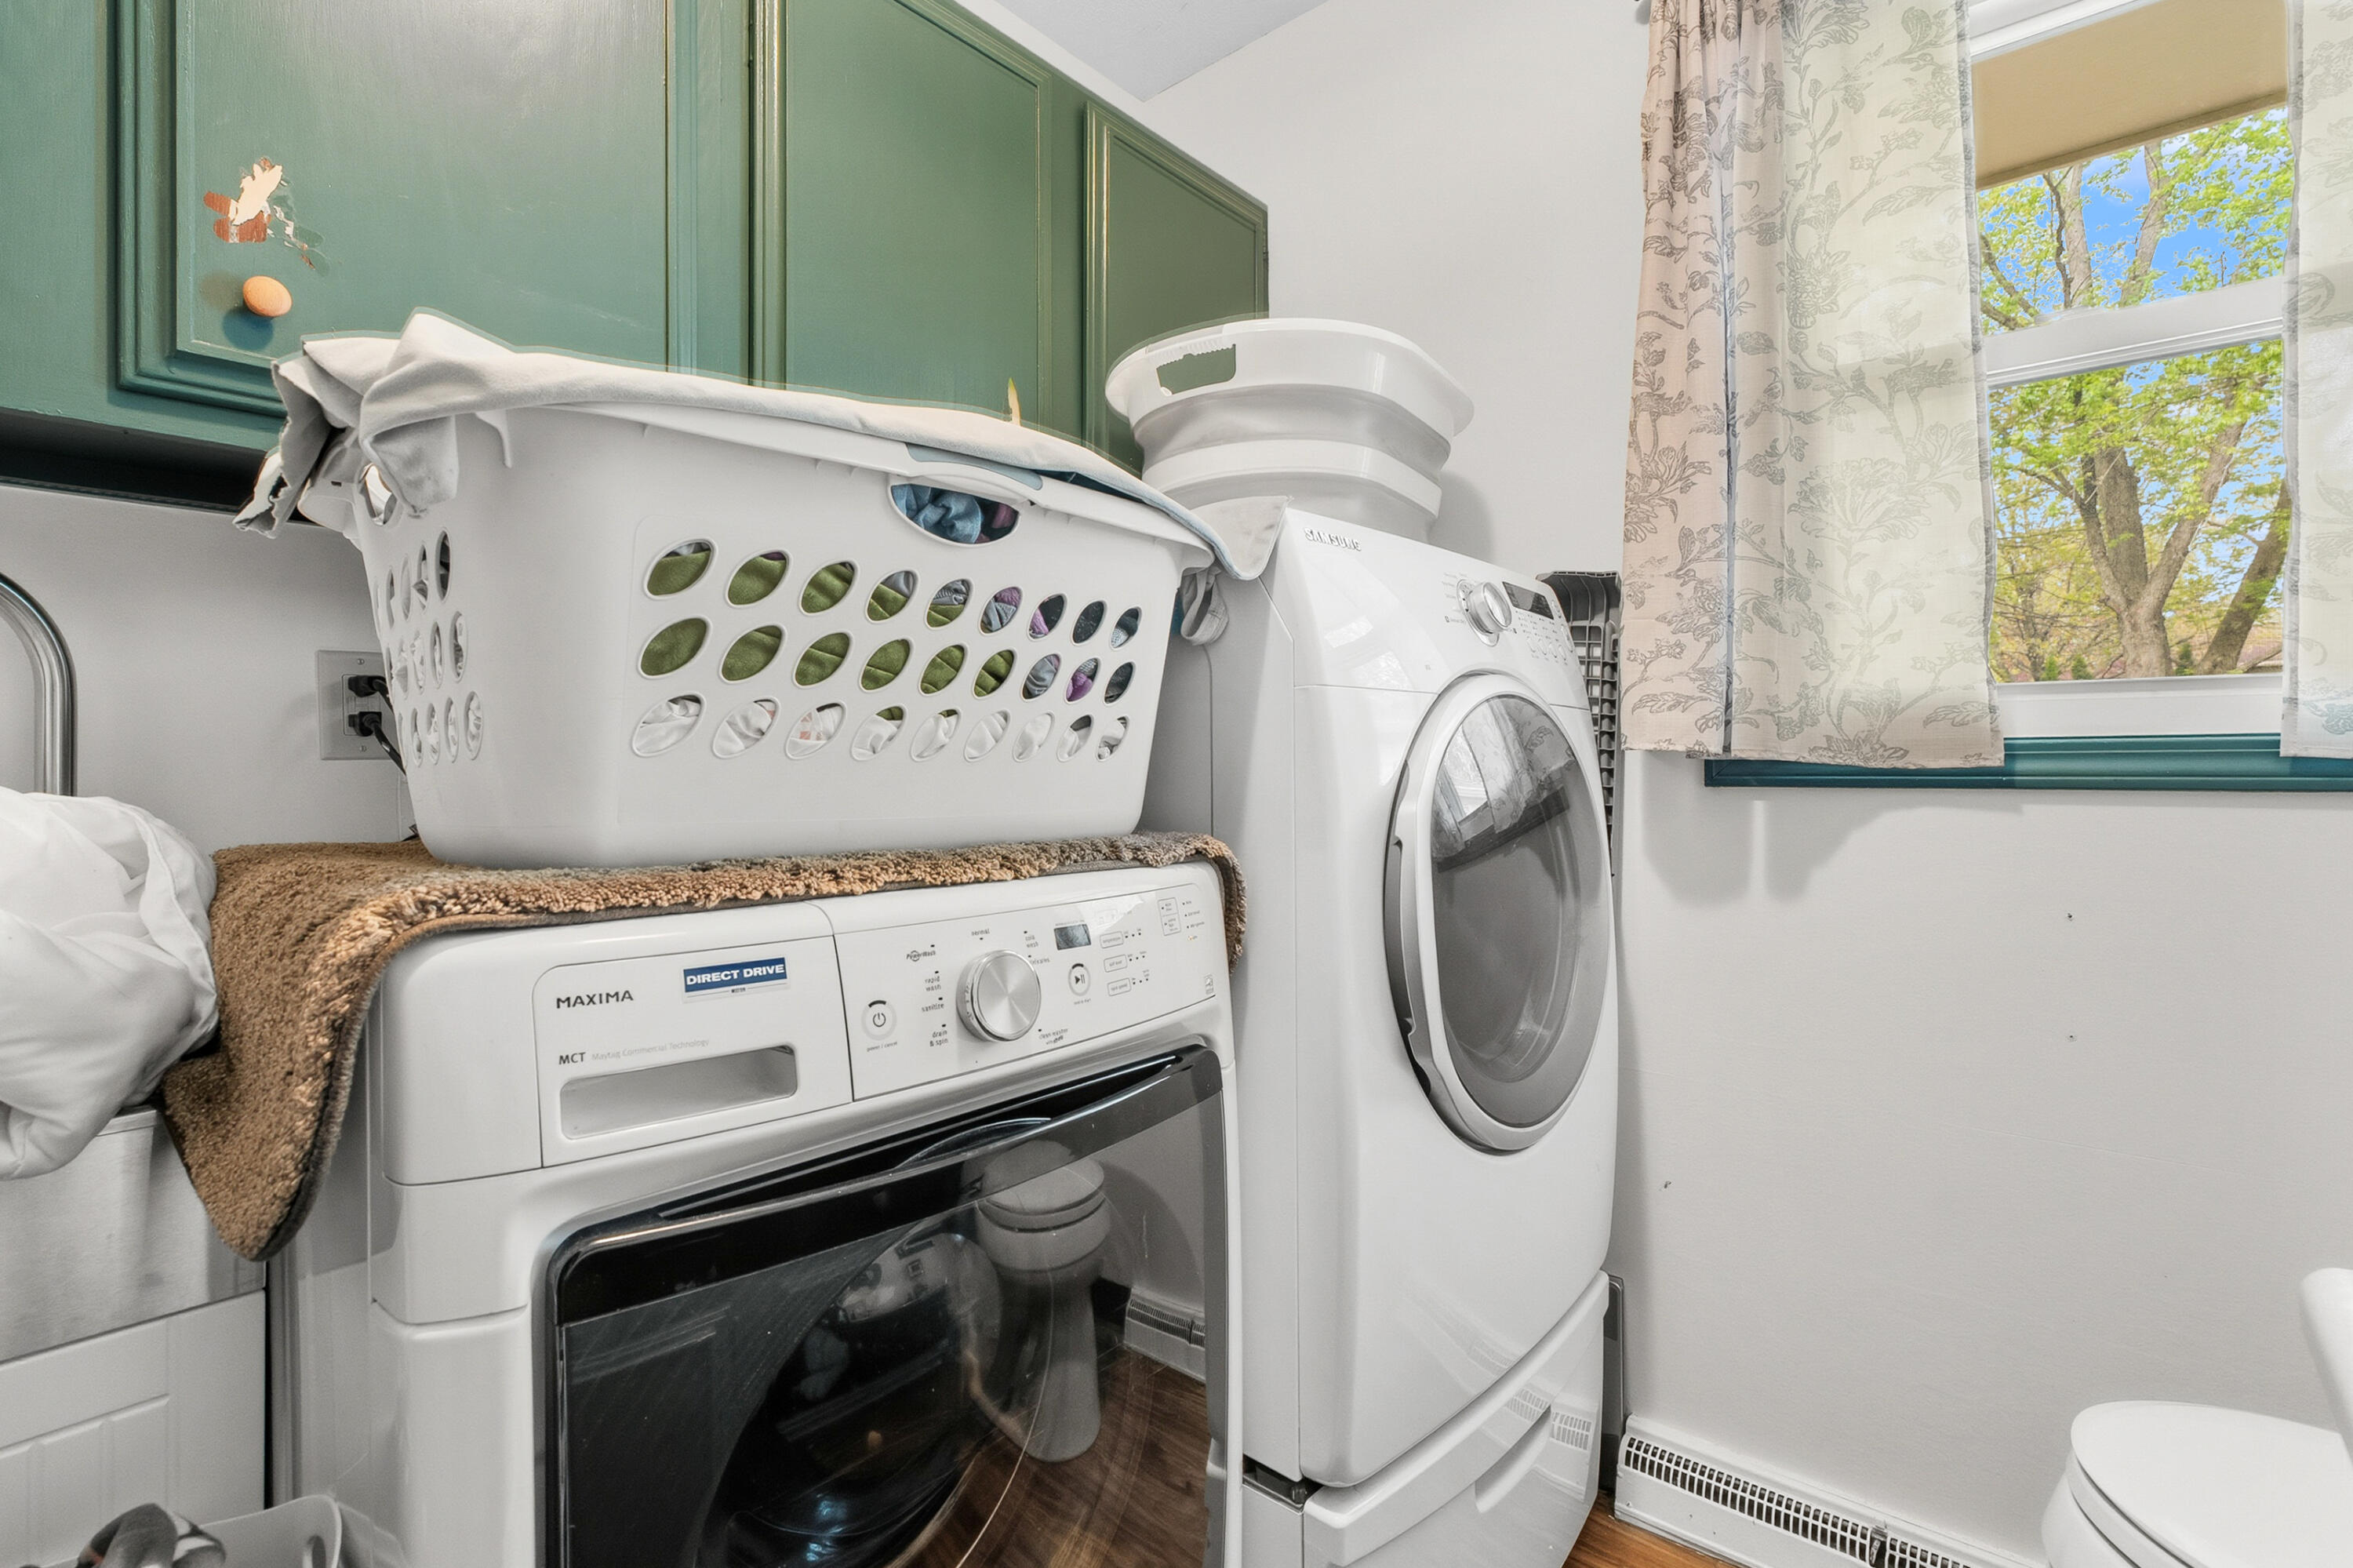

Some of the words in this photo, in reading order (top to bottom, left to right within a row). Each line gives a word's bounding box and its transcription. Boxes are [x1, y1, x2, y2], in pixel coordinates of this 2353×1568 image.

[1304, 527, 1362, 552] SAMSUNG
[686, 970, 740, 985] DIRECT
[743, 964, 785, 978] DRIVE
[556, 990, 634, 1010] MAXIMA
[559, 1052, 586, 1065] MCT
[591, 1051, 620, 1061] Maytag
[622, 1044, 667, 1057] Commercial
[669, 1039, 709, 1051] Technology
